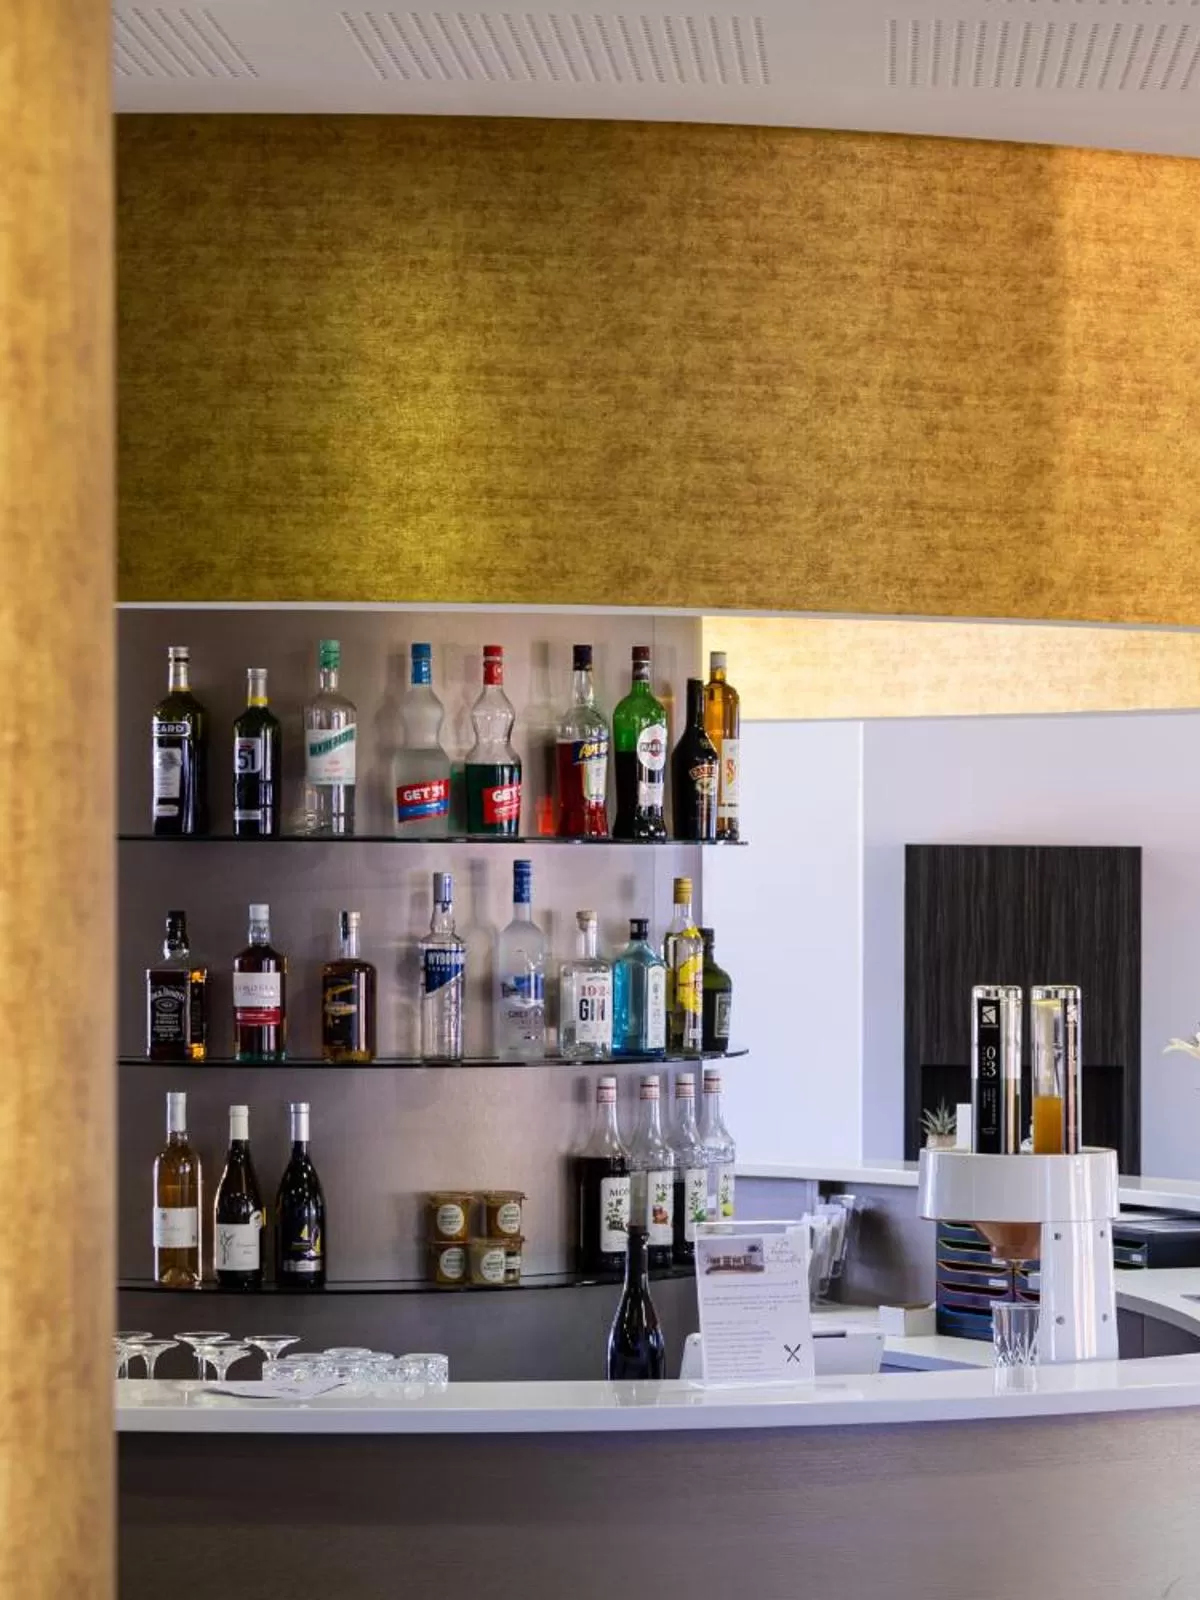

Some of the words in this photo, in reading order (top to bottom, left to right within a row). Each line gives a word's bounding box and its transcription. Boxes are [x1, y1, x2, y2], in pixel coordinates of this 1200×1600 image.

[238, 749, 256, 771] 51
[403, 787, 431, 801] GET
[492, 786, 518, 802] GET
[579, 998, 605, 1021] GIN
